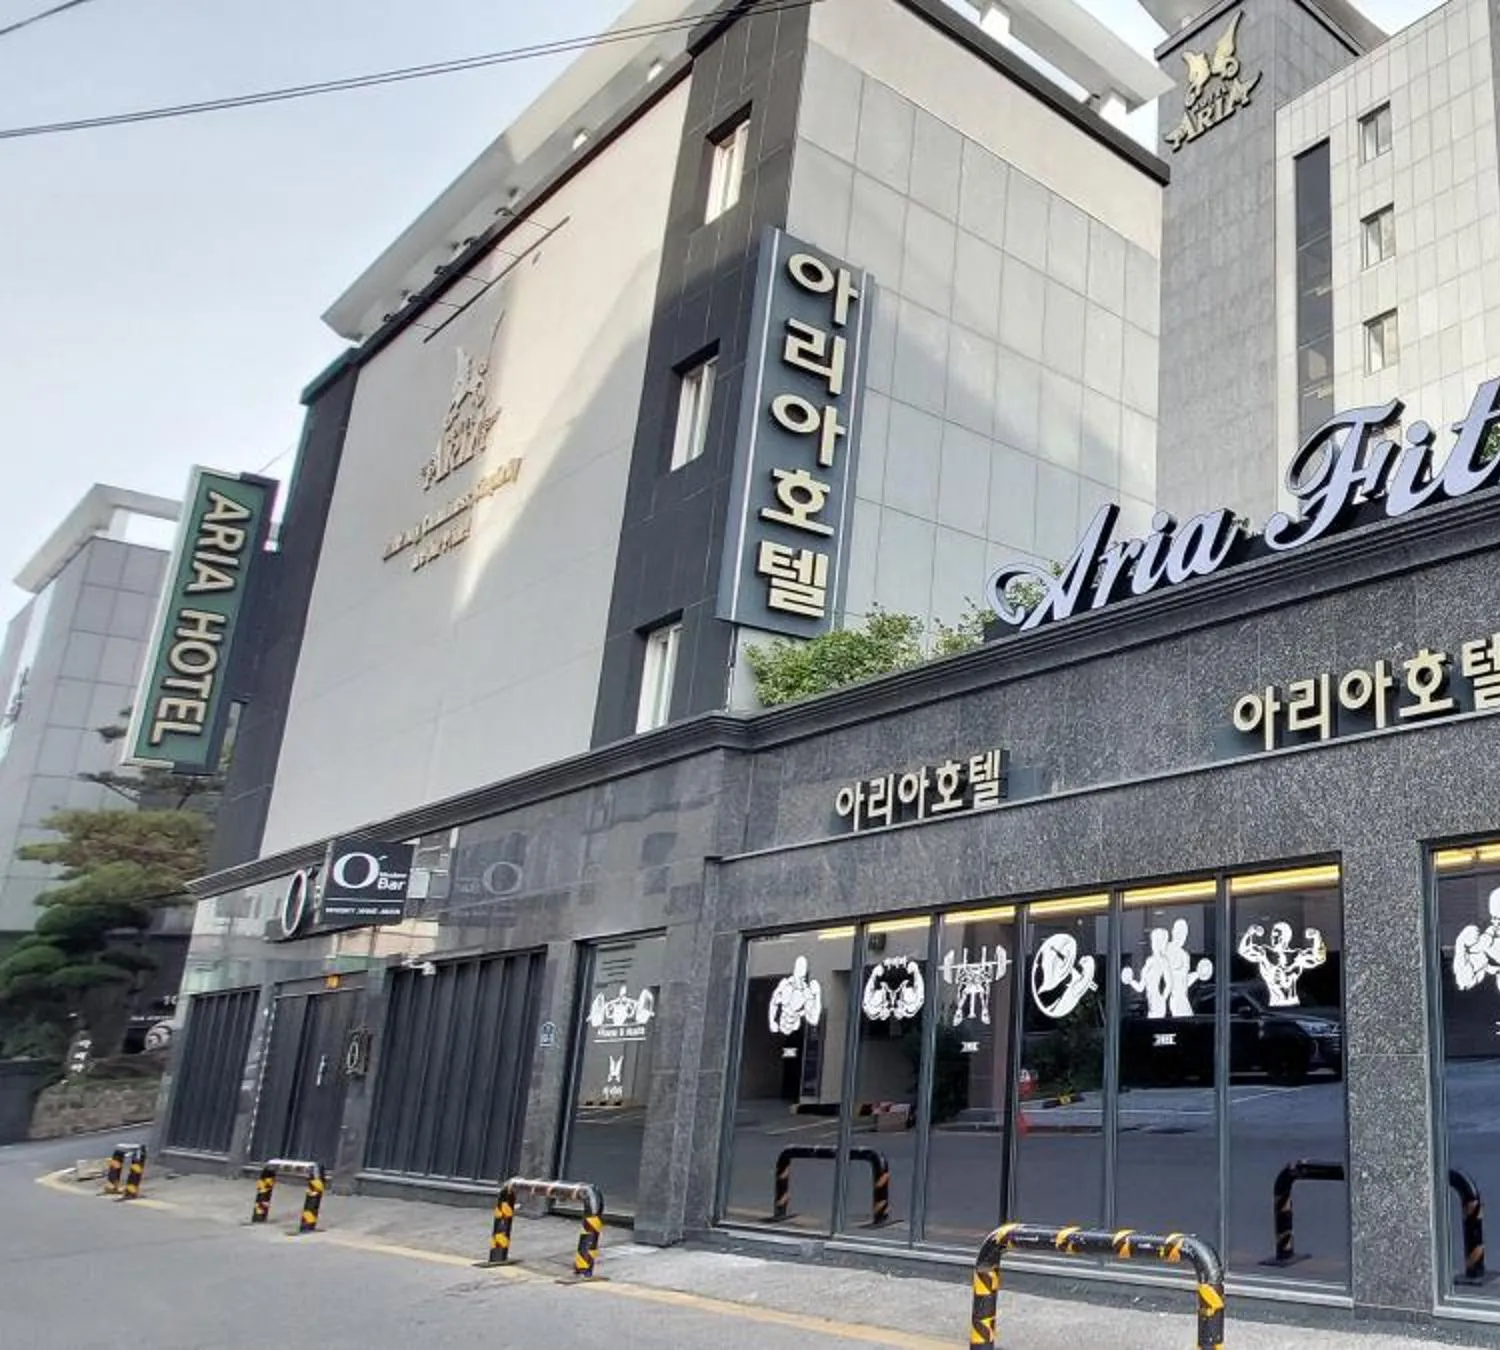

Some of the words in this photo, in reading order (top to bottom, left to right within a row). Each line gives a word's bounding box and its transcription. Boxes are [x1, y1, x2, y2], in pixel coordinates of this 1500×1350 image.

[758, 252, 859, 618] 아리아호텔
[185, 490, 251, 593] ARIA
[986, 501, 1240, 631] Aria
[149, 608, 227, 745] HOTEL
[836, 749, 1003, 832] 아리아호텔
[377, 878, 407, 890] Bar
